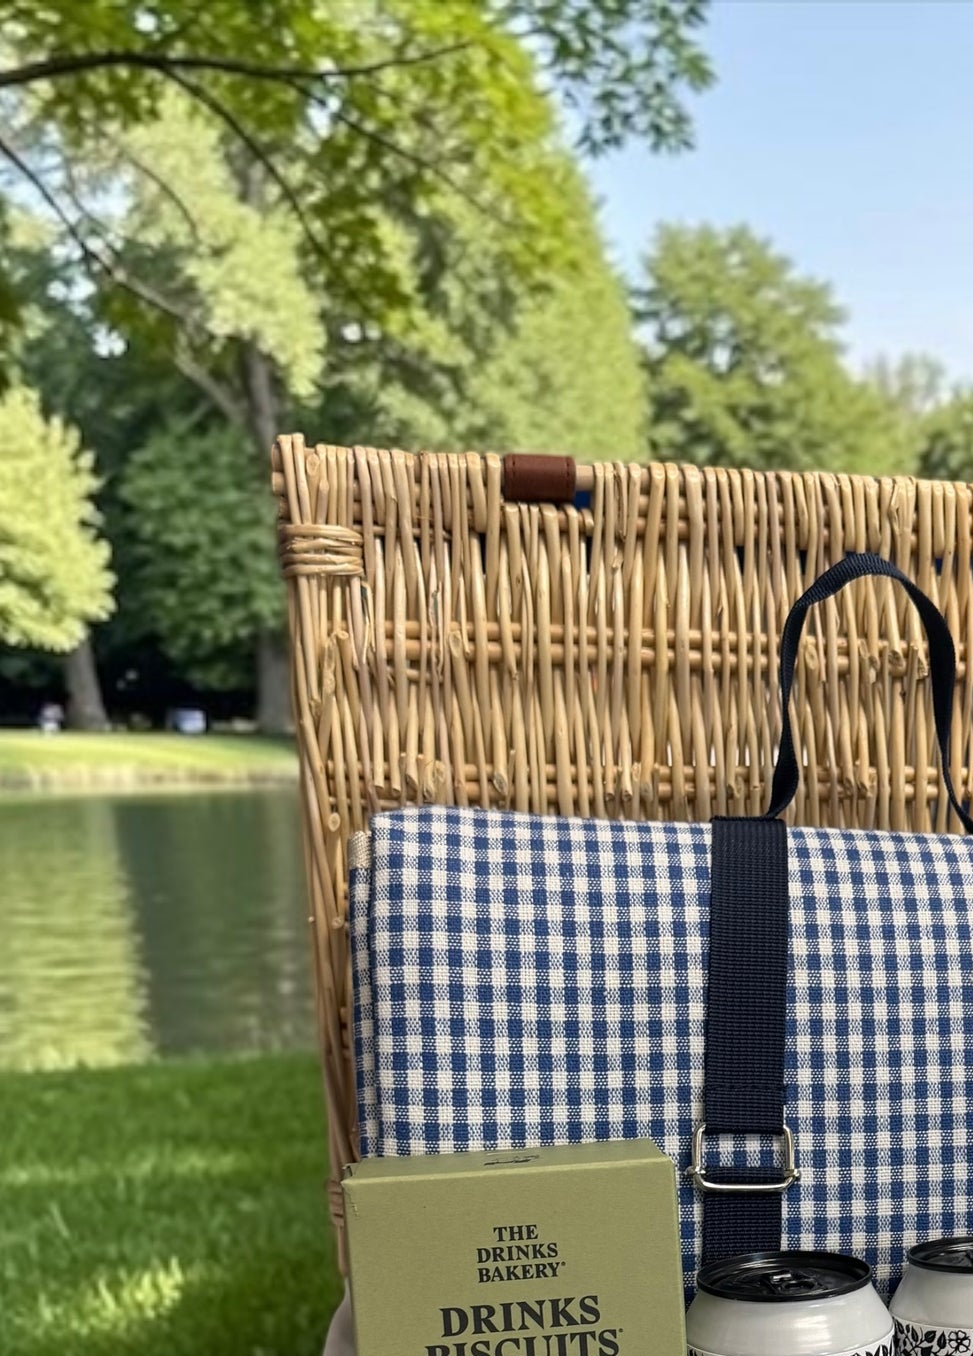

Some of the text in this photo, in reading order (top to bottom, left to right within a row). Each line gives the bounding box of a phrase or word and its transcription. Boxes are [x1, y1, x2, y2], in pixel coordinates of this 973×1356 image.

[493, 1225, 538, 1242] THE
[476, 1242, 559, 1263] DRINKS
[440, 1295, 601, 1338] DRINKS
